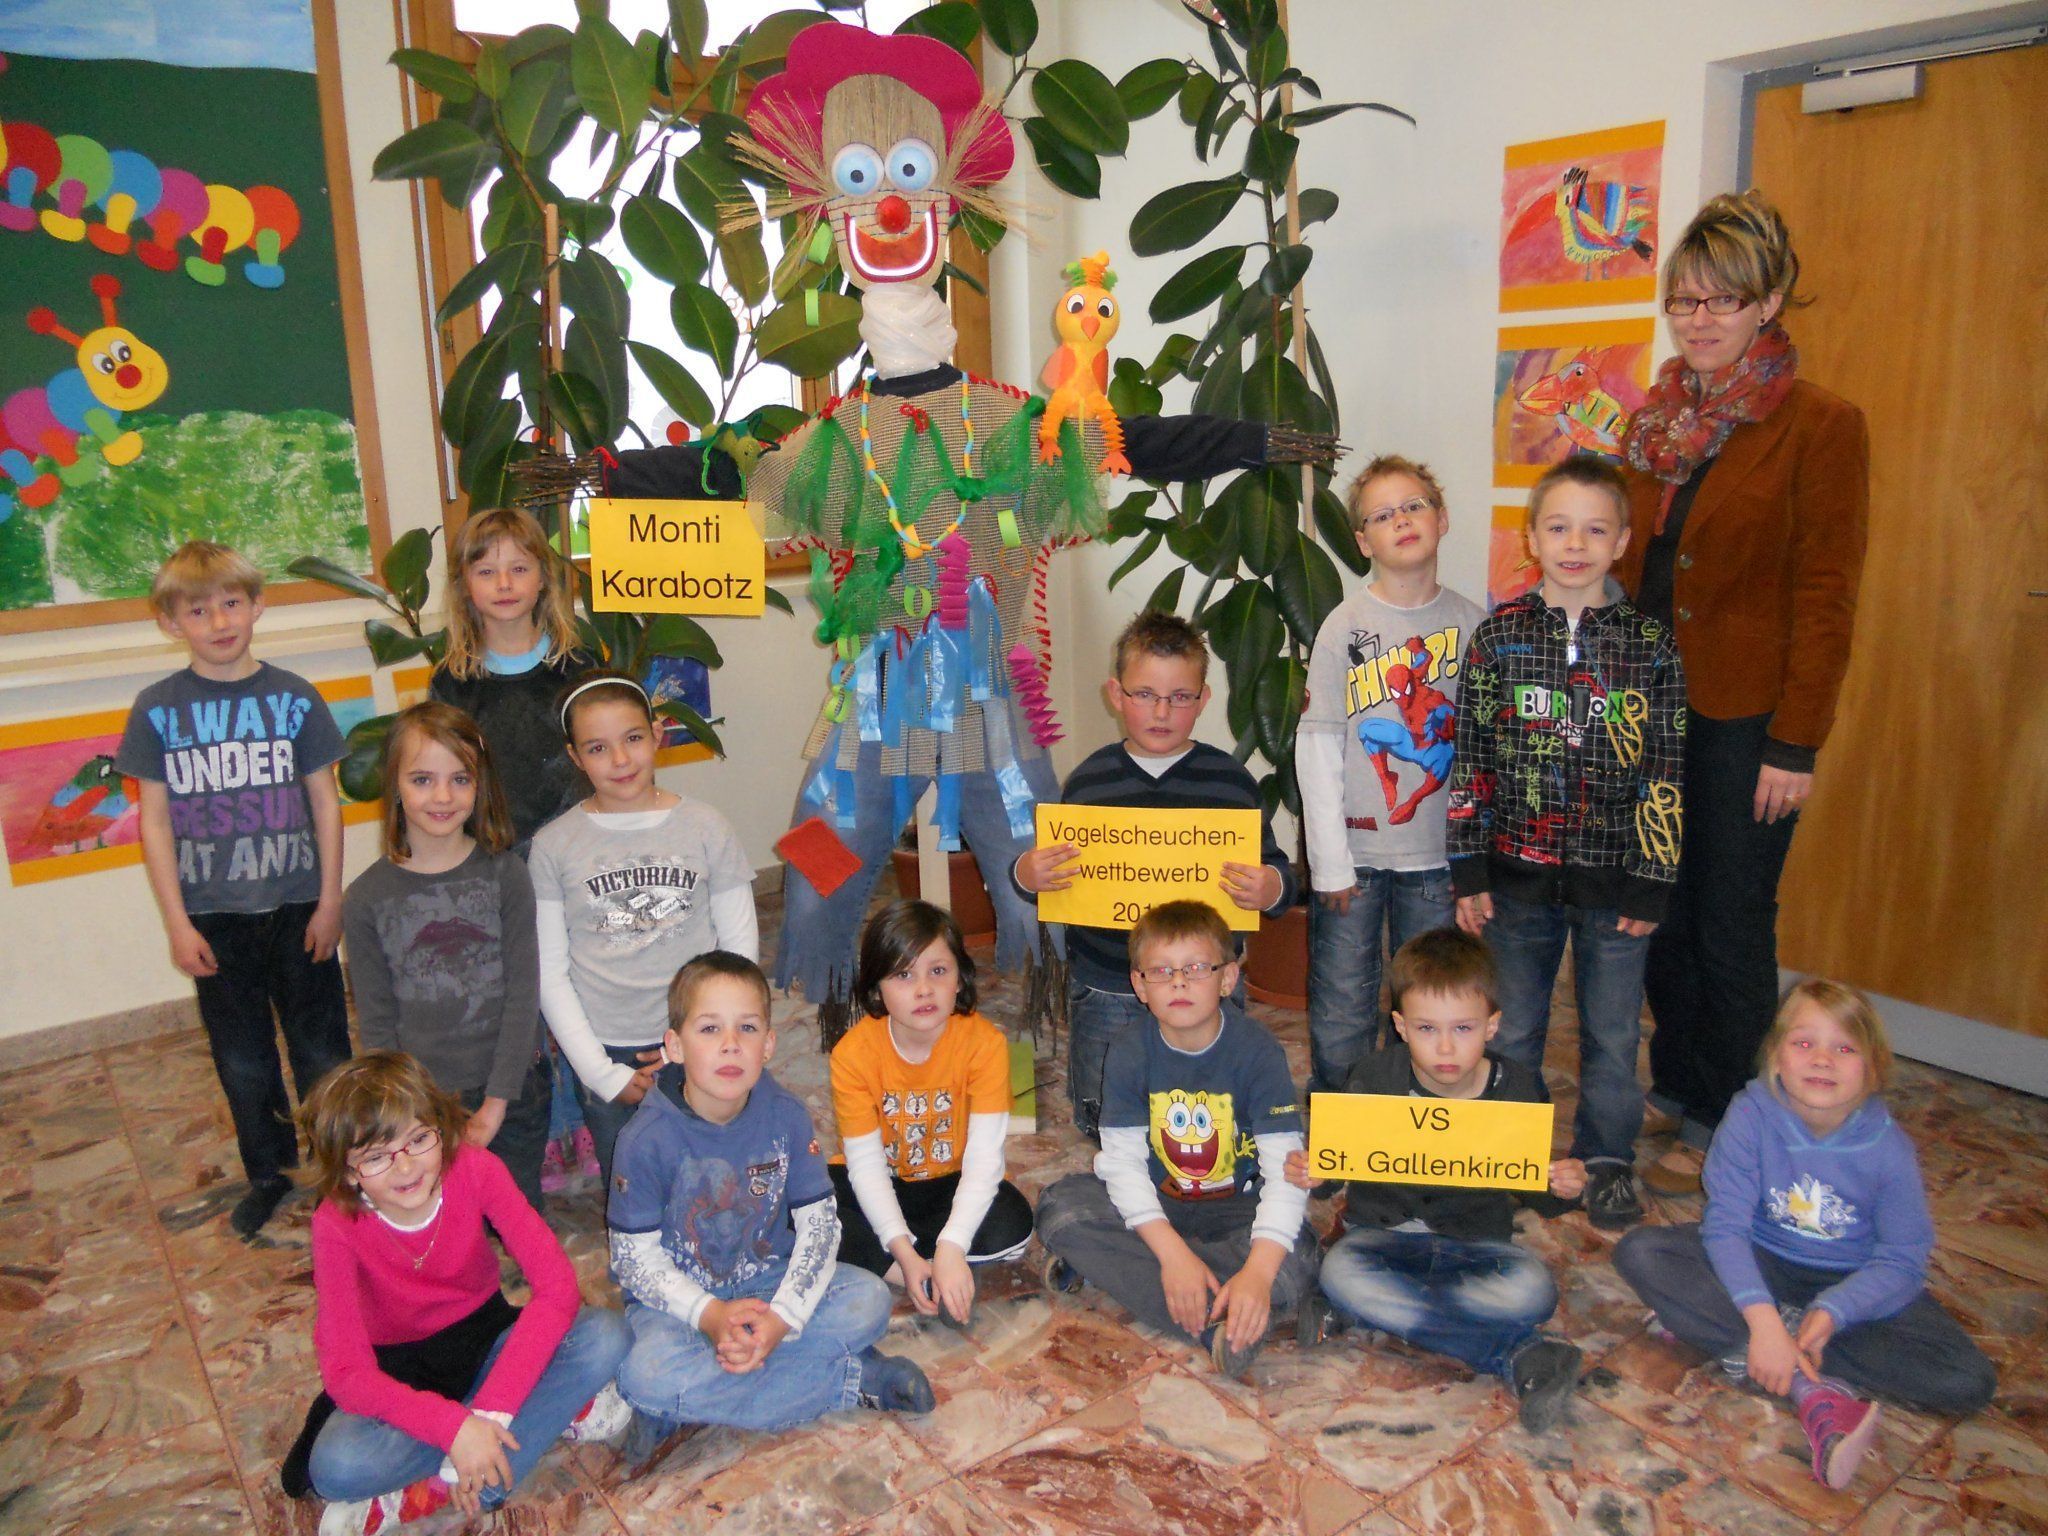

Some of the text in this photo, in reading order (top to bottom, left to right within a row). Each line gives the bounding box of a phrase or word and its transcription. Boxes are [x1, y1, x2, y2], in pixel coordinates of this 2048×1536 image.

[629, 514, 720, 543] Monti
[602, 569, 753, 599] Karabotz
[165, 739, 294, 794] UNDER
[1049, 821, 1245, 847] Vogelscheuchen-
[585, 866, 699, 898] VICTORIAN
[1080, 862, 1210, 882] wettbewerb
[1409, 1106, 1450, 1131] VS
[1317, 1148, 1540, 1181] St. Gallenkirch
